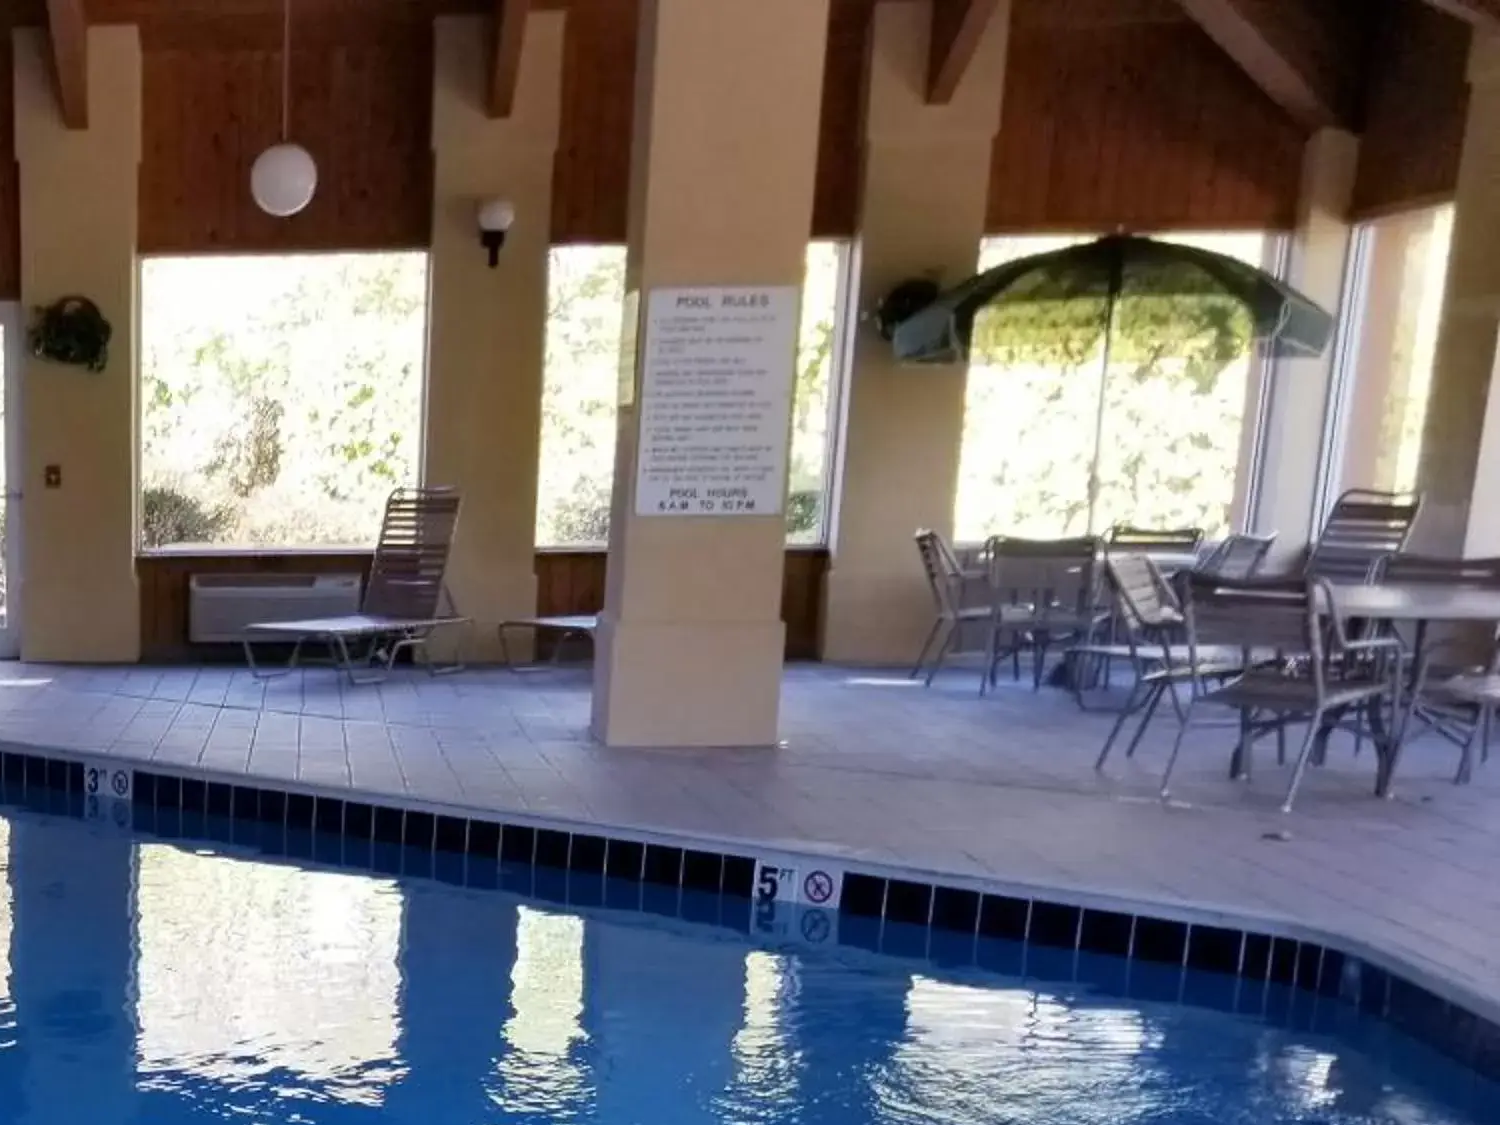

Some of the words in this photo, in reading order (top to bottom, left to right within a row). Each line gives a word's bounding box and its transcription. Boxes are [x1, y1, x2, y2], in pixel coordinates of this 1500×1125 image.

[675, 296, 712, 309] POOL
[721, 294, 770, 308] RULES
[669, 487, 699, 499] POOL
[706, 487, 748, 498] HOURS
[699, 500, 715, 510] TO
